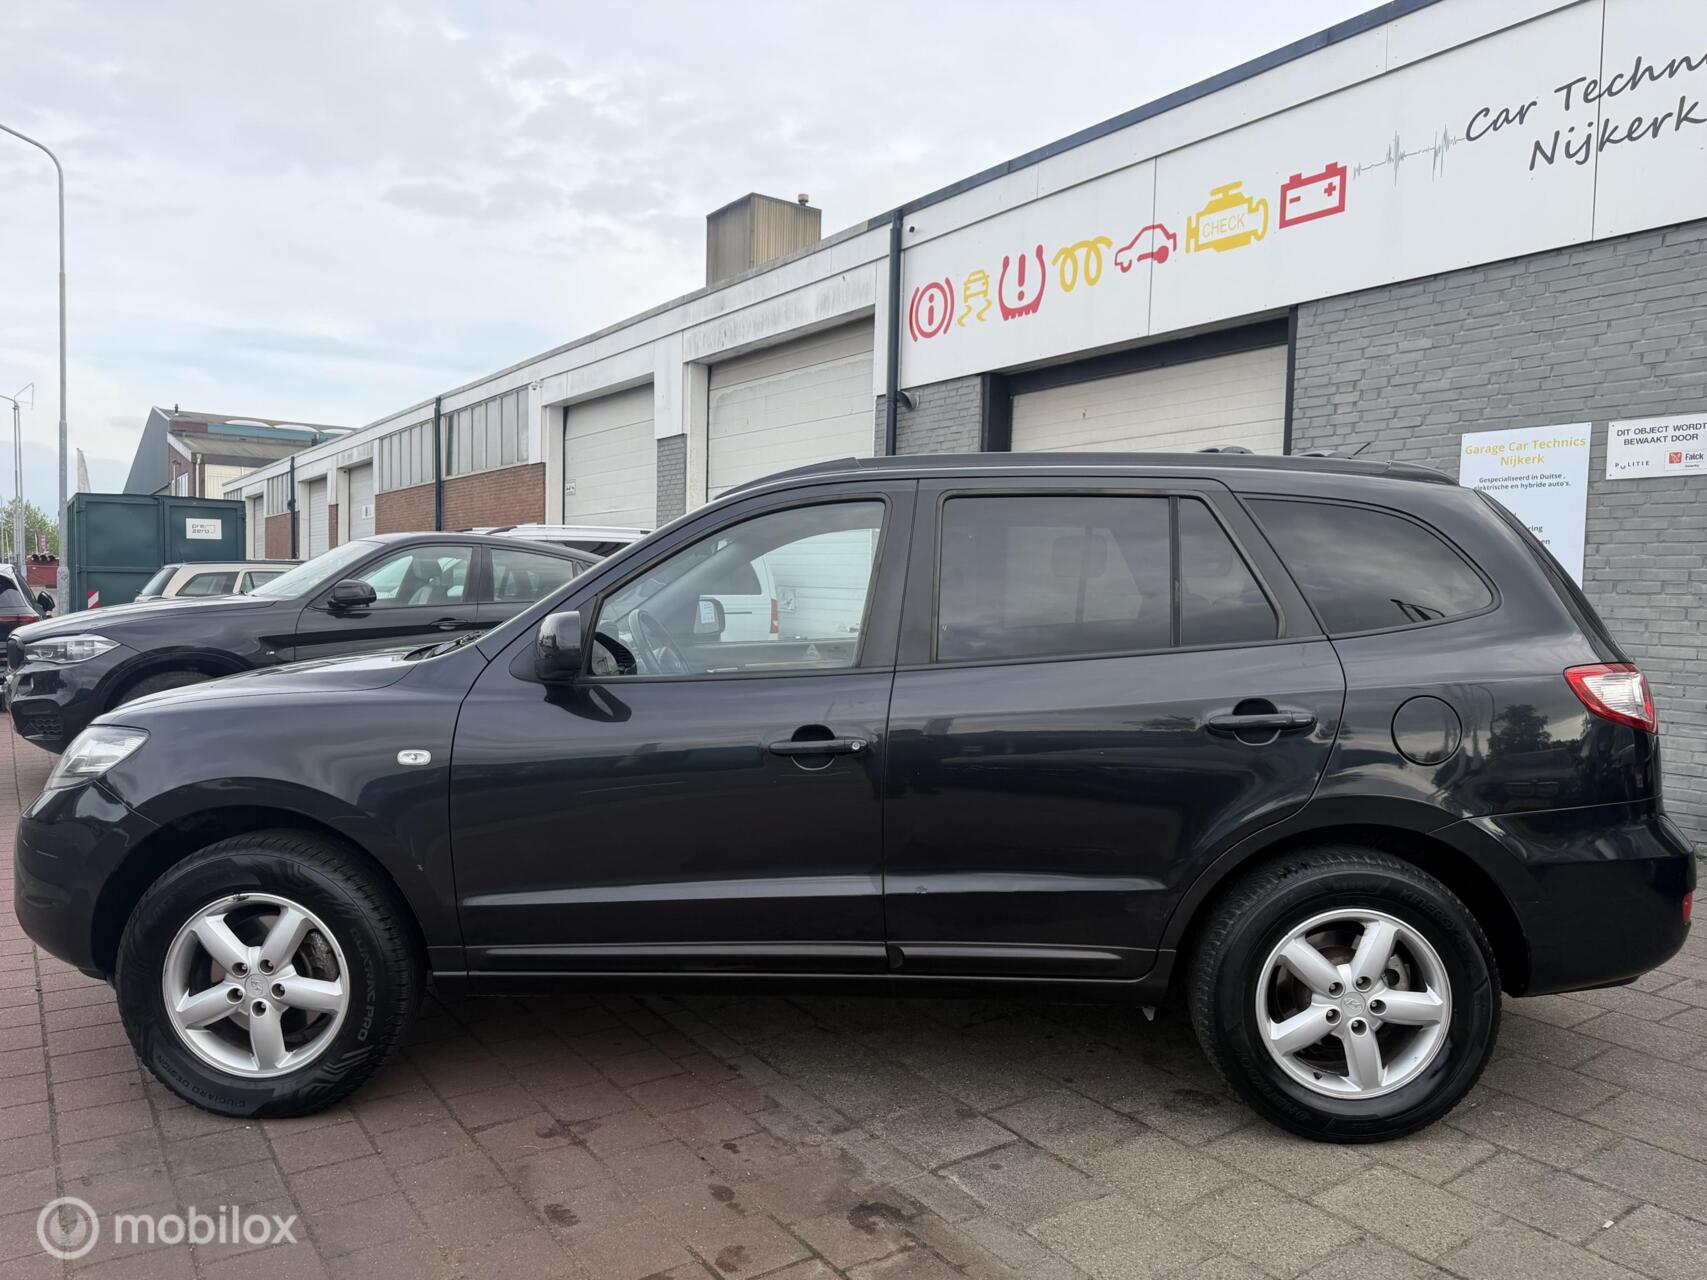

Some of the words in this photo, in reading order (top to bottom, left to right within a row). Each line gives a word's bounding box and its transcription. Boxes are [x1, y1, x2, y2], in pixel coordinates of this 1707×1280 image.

[1465, 101, 1537, 142] Car
[1553, 52, 1707, 111] Techn
[1529, 95, 1707, 171] Nijkerk
[1202, 214, 1245, 238] CHECK
[1616, 428, 1631, 437] DIT
[1634, 425, 1669, 435] OBJECT
[1673, 422, 1707, 432] WORDT
[1465, 444, 1505, 455] Garage
[1508, 441, 1529, 452] Car
[1532, 437, 1586, 449] Technics
[1623, 435, 1668, 446] BEWAAKT
[1671, 433, 1699, 442] DOOR
[1500, 454, 1544, 468] Nijkerk
[1685, 452, 1704, 461] Falck
[1479, 474, 1530, 485] Gespecialiseerd
[1520, 480, 1546, 490] hybride
[357, 1004, 377, 1043] PRO
